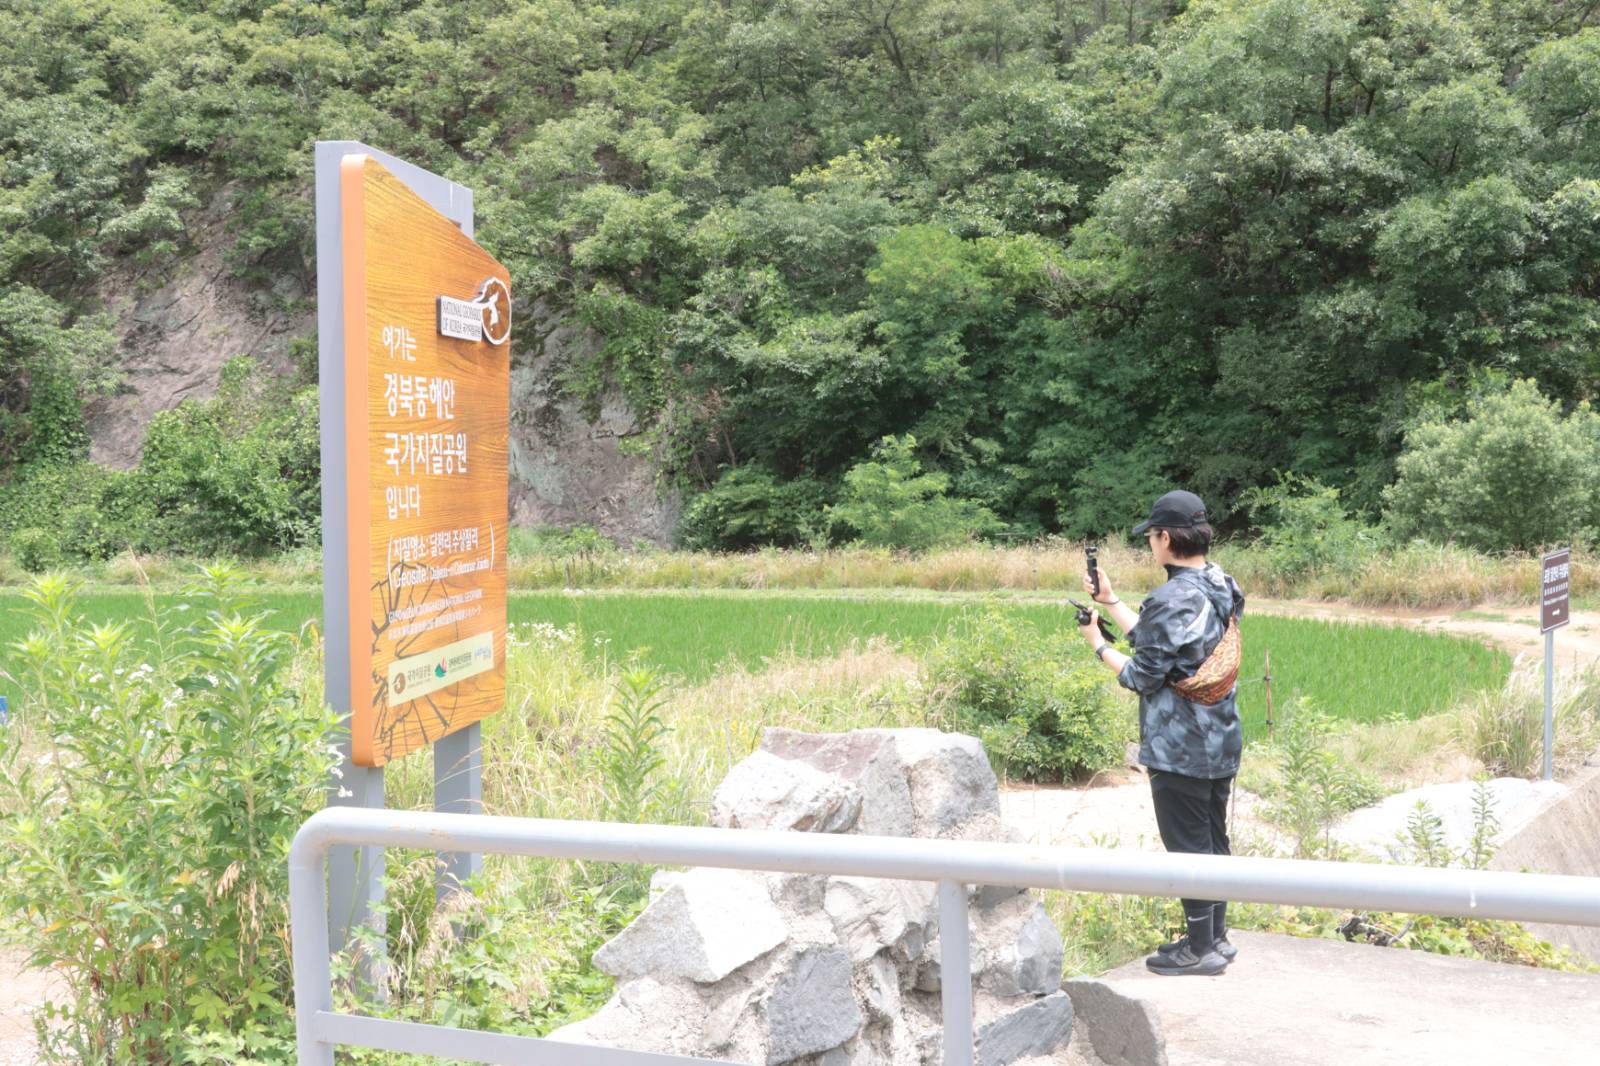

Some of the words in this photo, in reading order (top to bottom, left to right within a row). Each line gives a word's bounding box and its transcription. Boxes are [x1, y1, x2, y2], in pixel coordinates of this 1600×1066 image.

[383, 326, 416, 361] 여기는
[384, 373, 455, 419] 경북동해안
[384, 432, 467, 476] 국가지질공원
[385, 484, 421, 520] 입니다
